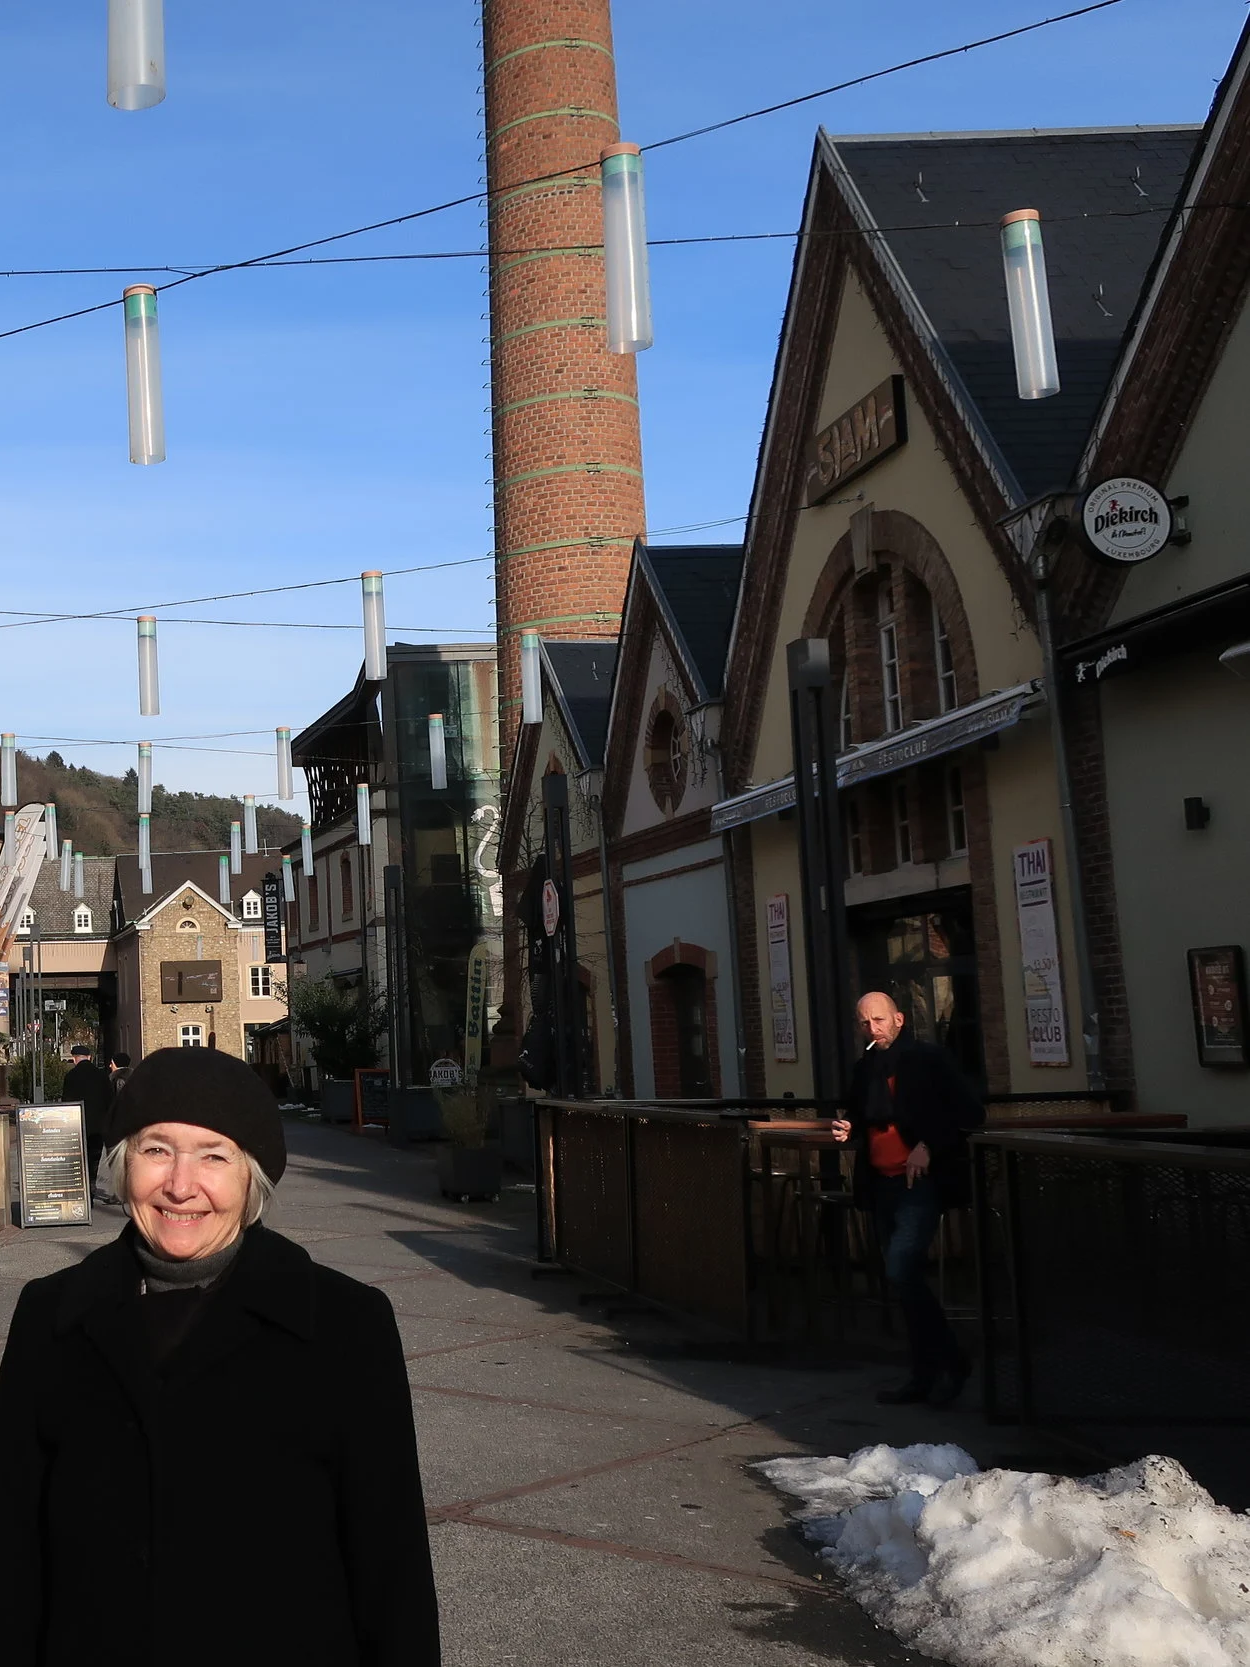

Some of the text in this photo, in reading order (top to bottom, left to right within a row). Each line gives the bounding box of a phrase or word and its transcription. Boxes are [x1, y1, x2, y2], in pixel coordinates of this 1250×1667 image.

[815, 395, 880, 486] SIAM
[1088, 481, 1159, 513] ORIGINAL PREMIUM
[1094, 504, 1159, 535] Diekirch
[1105, 537, 1161, 558] LUXEMBOURG
[1017, 848, 1047, 878] THAI
[264, 883, 279, 934] JAKOB'S
[468, 958, 483, 1038] Battin
[1032, 1026, 1062, 1043] CLUB
